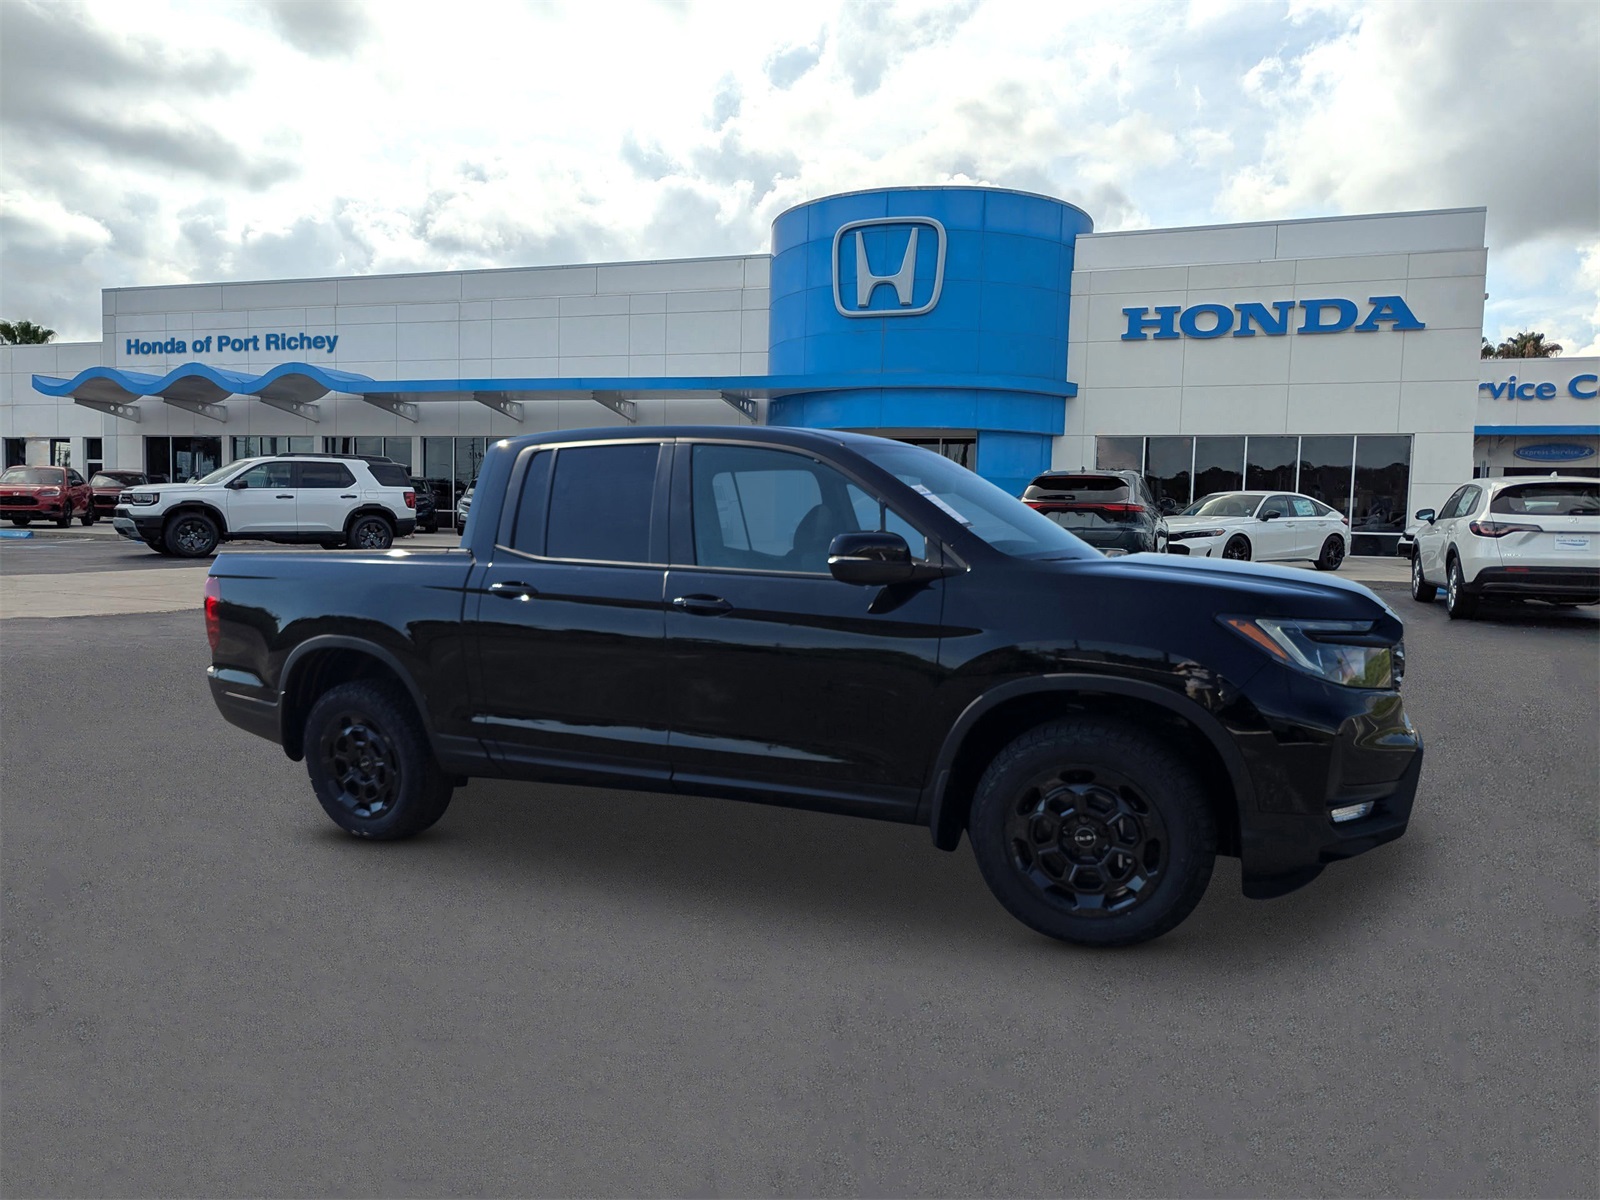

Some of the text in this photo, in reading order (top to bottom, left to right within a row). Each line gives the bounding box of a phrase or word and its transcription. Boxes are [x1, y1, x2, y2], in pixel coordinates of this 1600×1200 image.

[1121, 295, 1425, 340] HONDA
[126, 331, 339, 355] Honda of Port Richey
[1568, 374, 1600, 399] C
